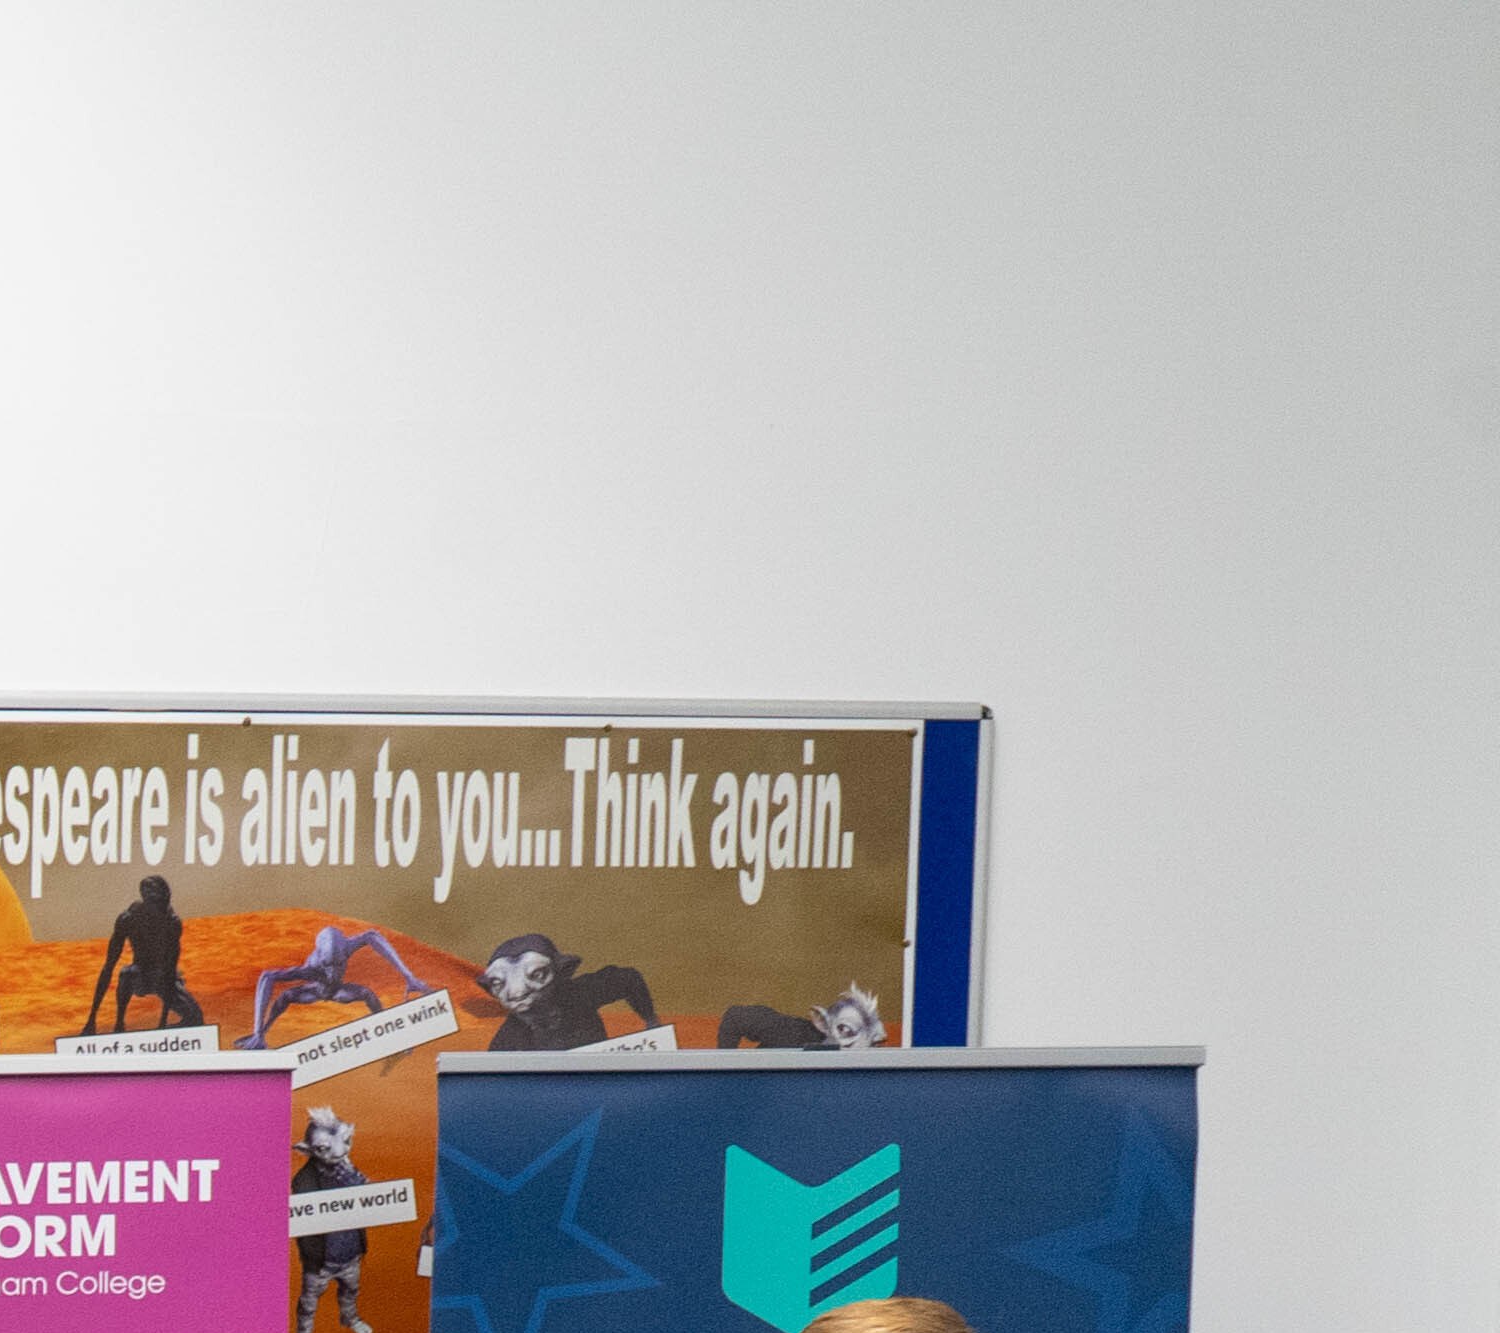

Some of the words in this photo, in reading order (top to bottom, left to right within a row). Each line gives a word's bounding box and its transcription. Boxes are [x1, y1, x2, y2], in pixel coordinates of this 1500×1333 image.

[184, 733, 224, 867] is
[240, 734, 356, 868] alien
[374, 737, 422, 868] to
[710, 740, 855, 906] again.
[139, 1036, 202, 1053] sudden
[297, 1044, 327, 1065] not
[329, 1027, 371, 1056] slept
[373, 1016, 405, 1038] one
[407, 999, 449, 1025] wink
[319, 1197, 355, 1215] new
[359, 1186, 409, 1209] world
[56, 1270, 166, 1302] College
